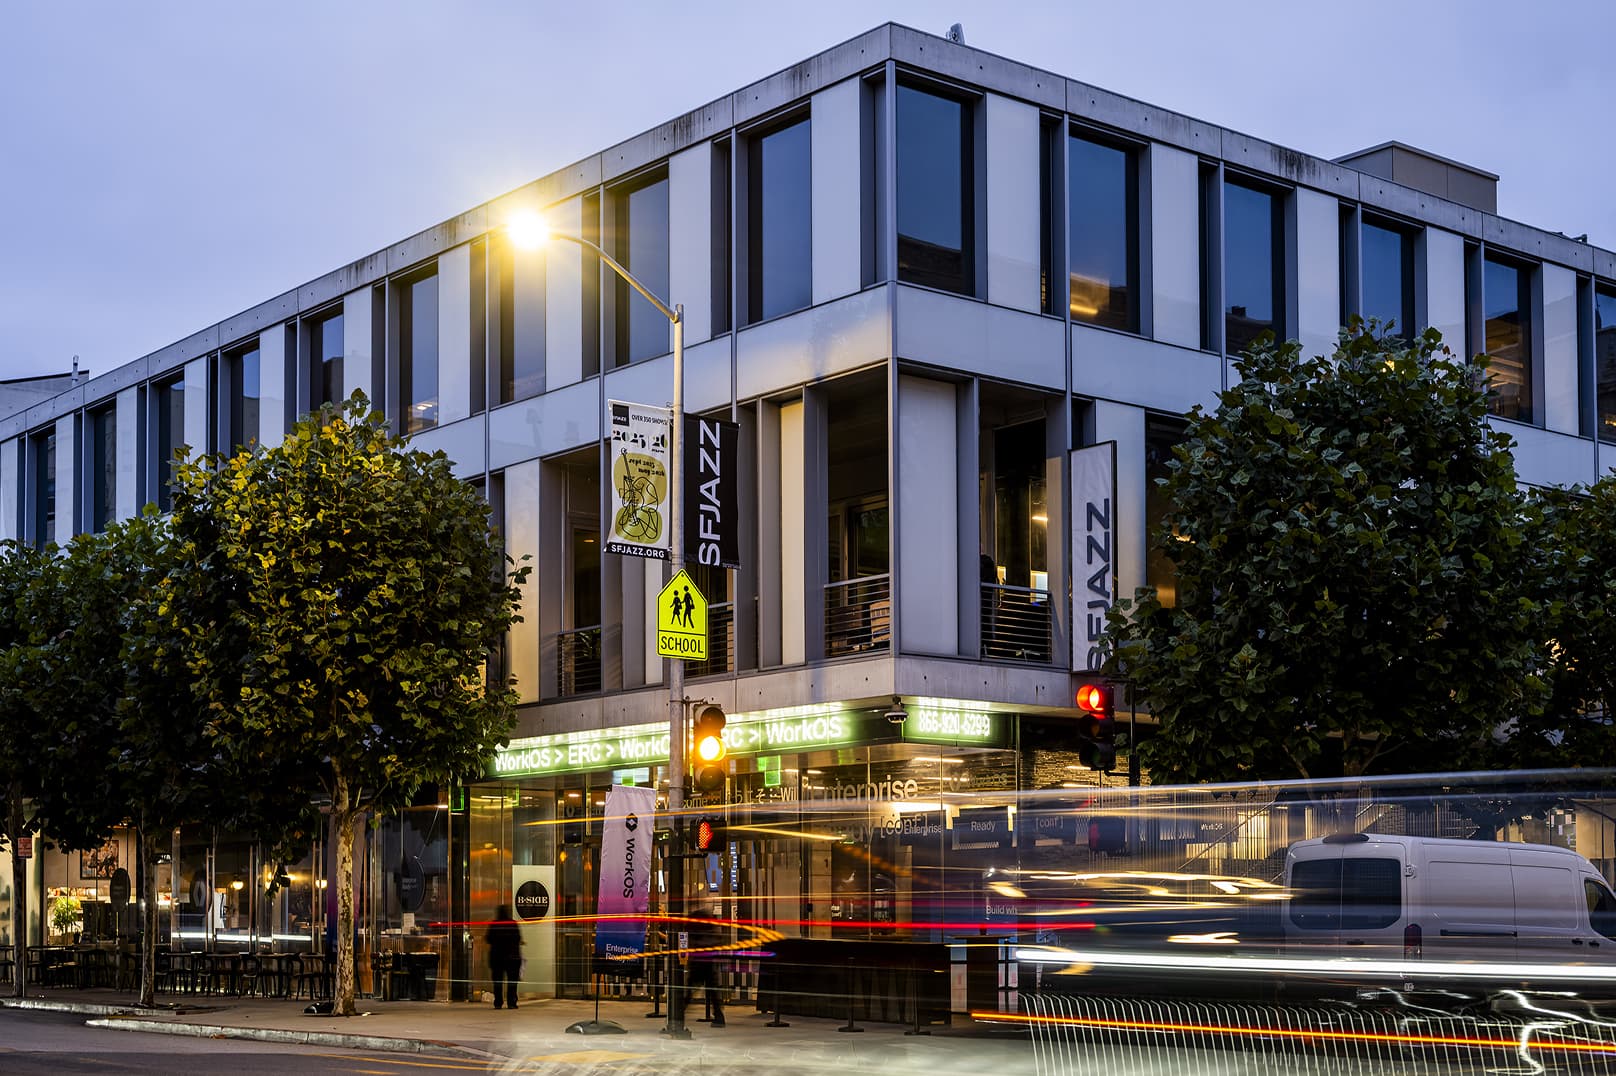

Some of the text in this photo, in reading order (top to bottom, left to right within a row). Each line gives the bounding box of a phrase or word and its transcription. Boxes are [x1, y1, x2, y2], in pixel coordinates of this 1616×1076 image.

[698, 421, 721, 566] SFJAZZ
[611, 544, 665, 558] SFJAZZ.ORG
[660, 635, 704, 653] SCHOOL
[720, 727, 744, 749] RC
[765, 716, 843, 745] WorkOS
[495, 748, 550, 772] WorkOS
[568, 742, 601, 765] ERC
[809, 774, 918, 804] nterprise
[971, 821, 996, 832] Ready
[623, 838, 635, 898] WorkOS
[986, 905, 1005, 915] Build
[606, 943, 638, 955] Enterprise
